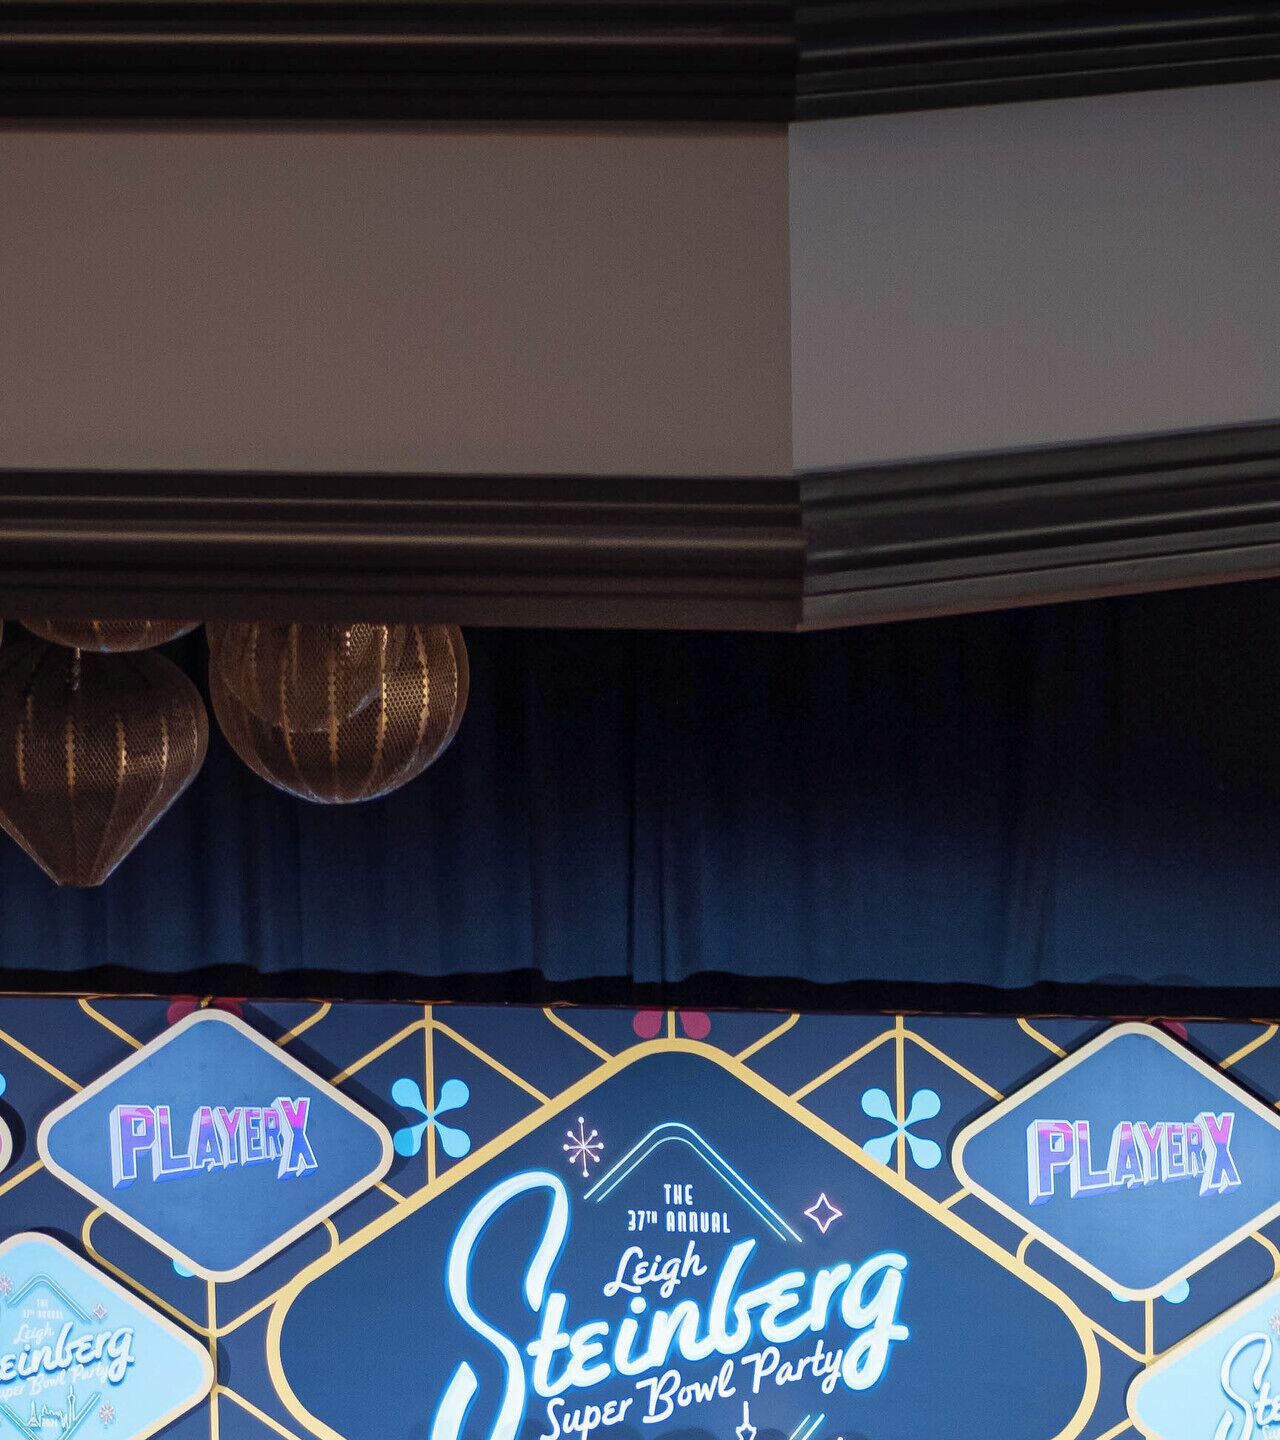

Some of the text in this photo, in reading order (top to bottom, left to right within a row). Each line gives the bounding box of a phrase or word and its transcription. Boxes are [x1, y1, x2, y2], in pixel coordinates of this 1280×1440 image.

[109, 1096, 319, 1190] PLAYERX
[1026, 1111, 1242, 1206] PLAYERX
[663, 1184, 693, 1205] THE
[627, 1210, 730, 1233] 37TH ANNUAL
[604, 1240, 707, 1297] Leigh
[13, 1323, 54, 1344] Leigh
[27, 1371, 66, 1396] Bowl
[70, 1363, 110, 1383] Party
[636, 1359, 736, 1423] Bowl
[741, 1339, 845, 1394] Party
